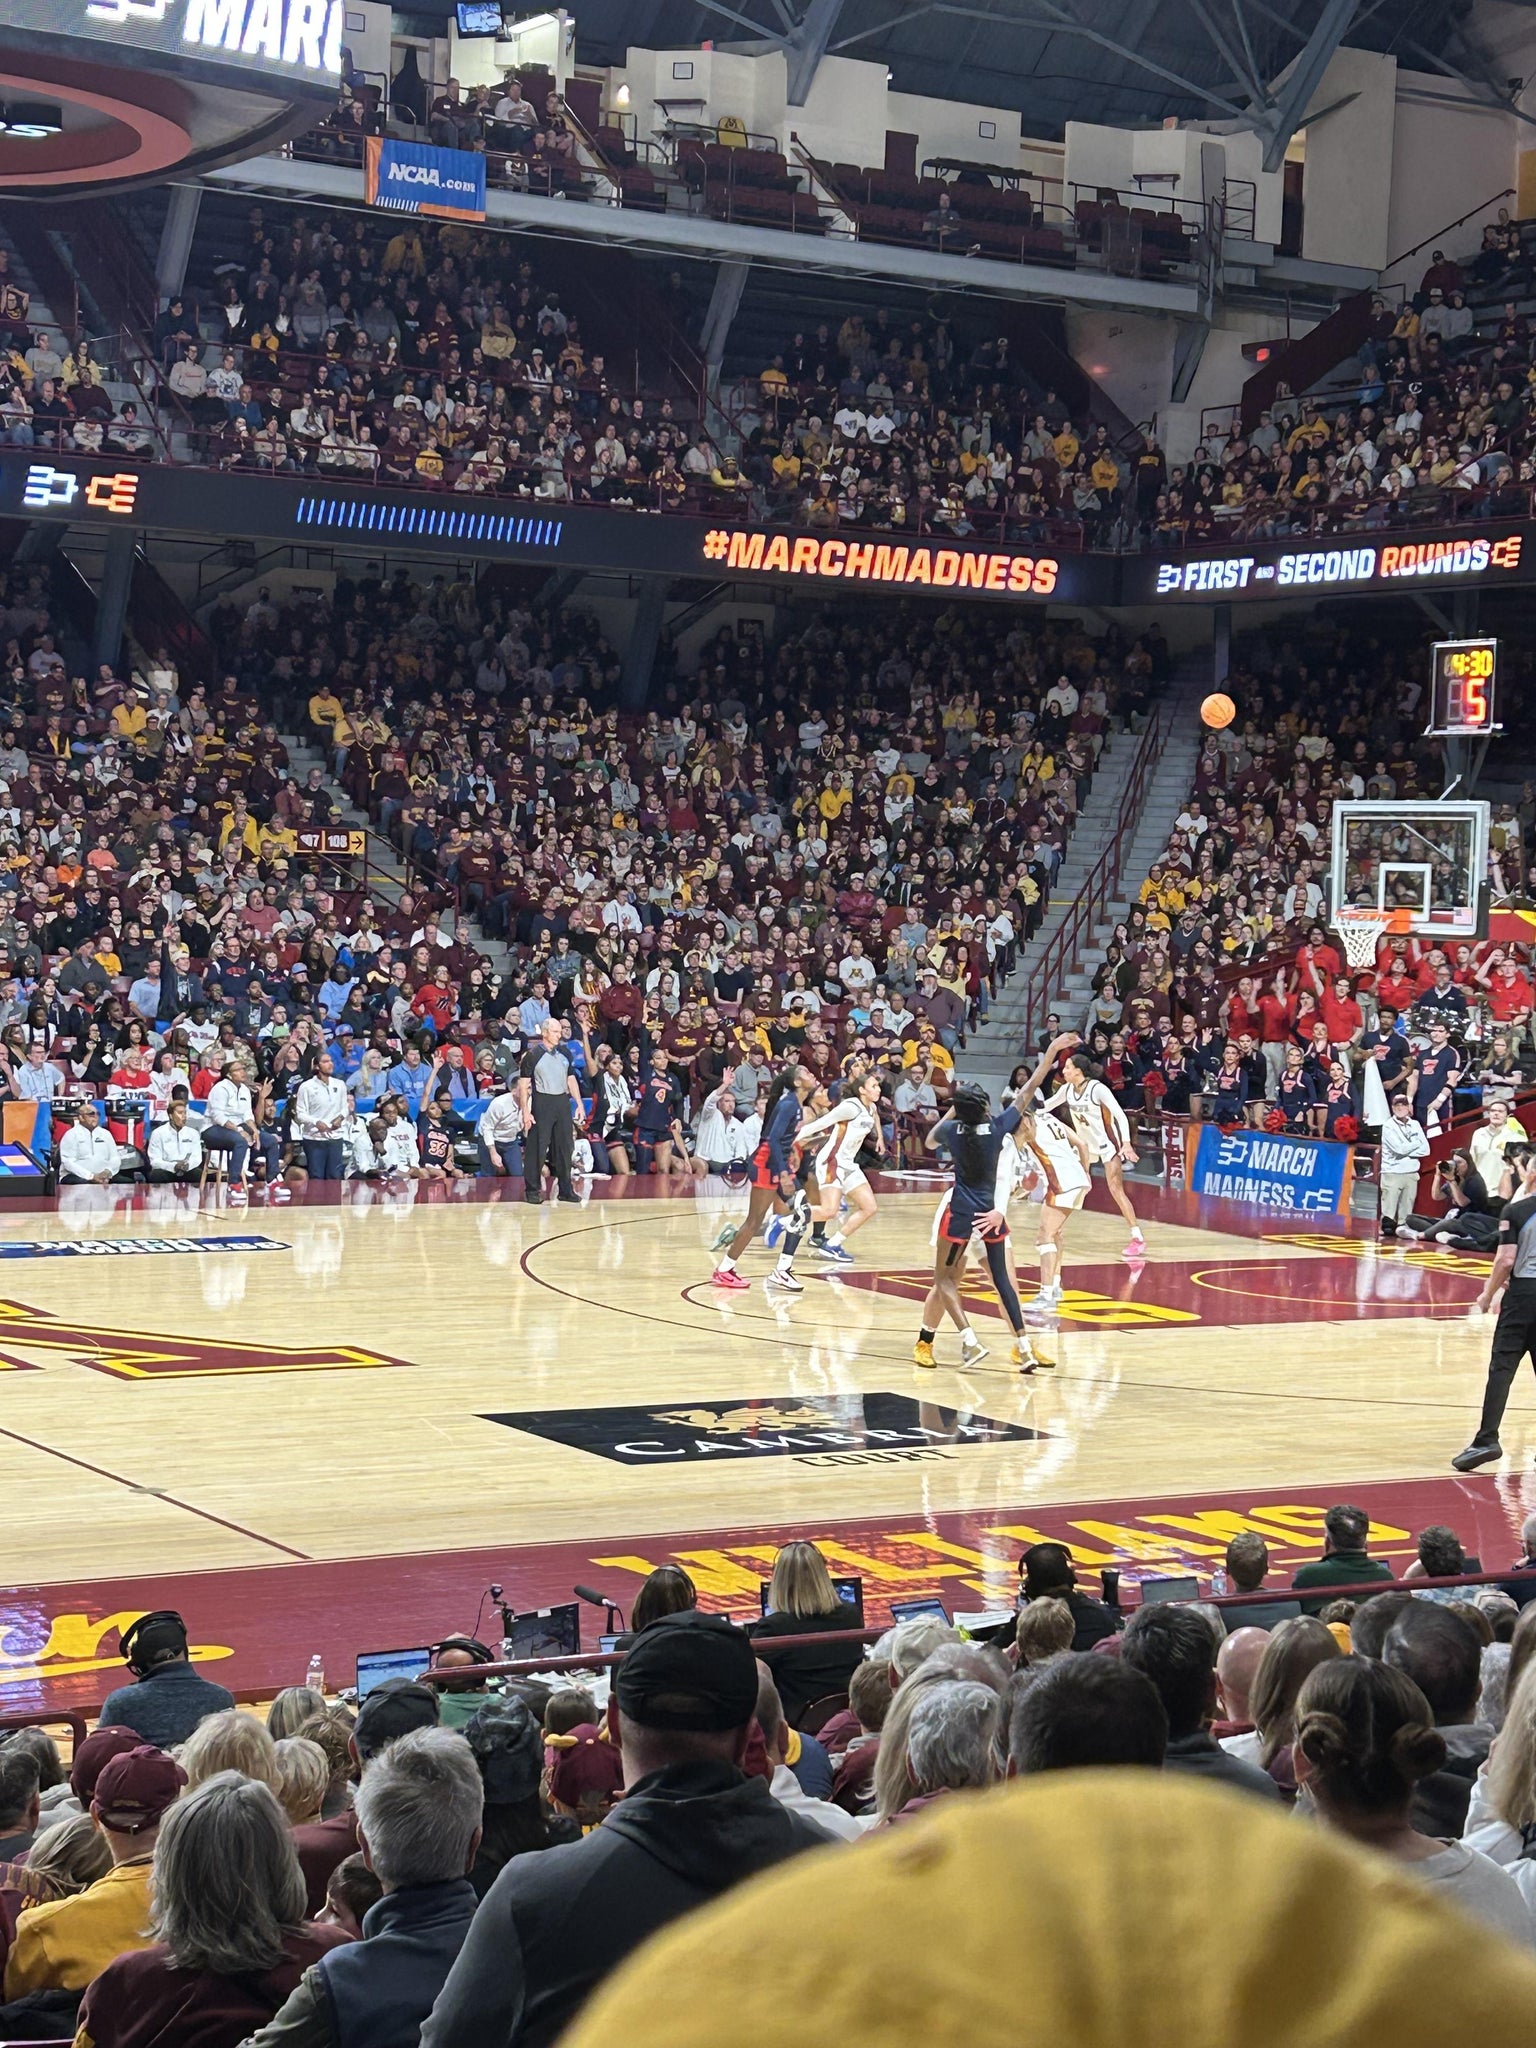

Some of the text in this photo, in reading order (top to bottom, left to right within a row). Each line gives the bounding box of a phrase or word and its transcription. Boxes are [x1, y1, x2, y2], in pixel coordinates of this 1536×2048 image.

[388, 162, 476, 193] NCAA.com
[703, 529, 1059, 594] #MARCHMADNESS
[1184, 558, 1255, 592] FIRST
[1277, 547, 1376, 585] SECOND
[1380, 540, 1491, 578] ROUNDS
[1466, 677, 1487, 723] 5
[1248, 1140, 1318, 1177] MARCH
[1204, 1171, 1295, 1211] MADNESS
[614, 1421, 1012, 1457] CAMBRIA
[791, 1448, 960, 1469] COURT
